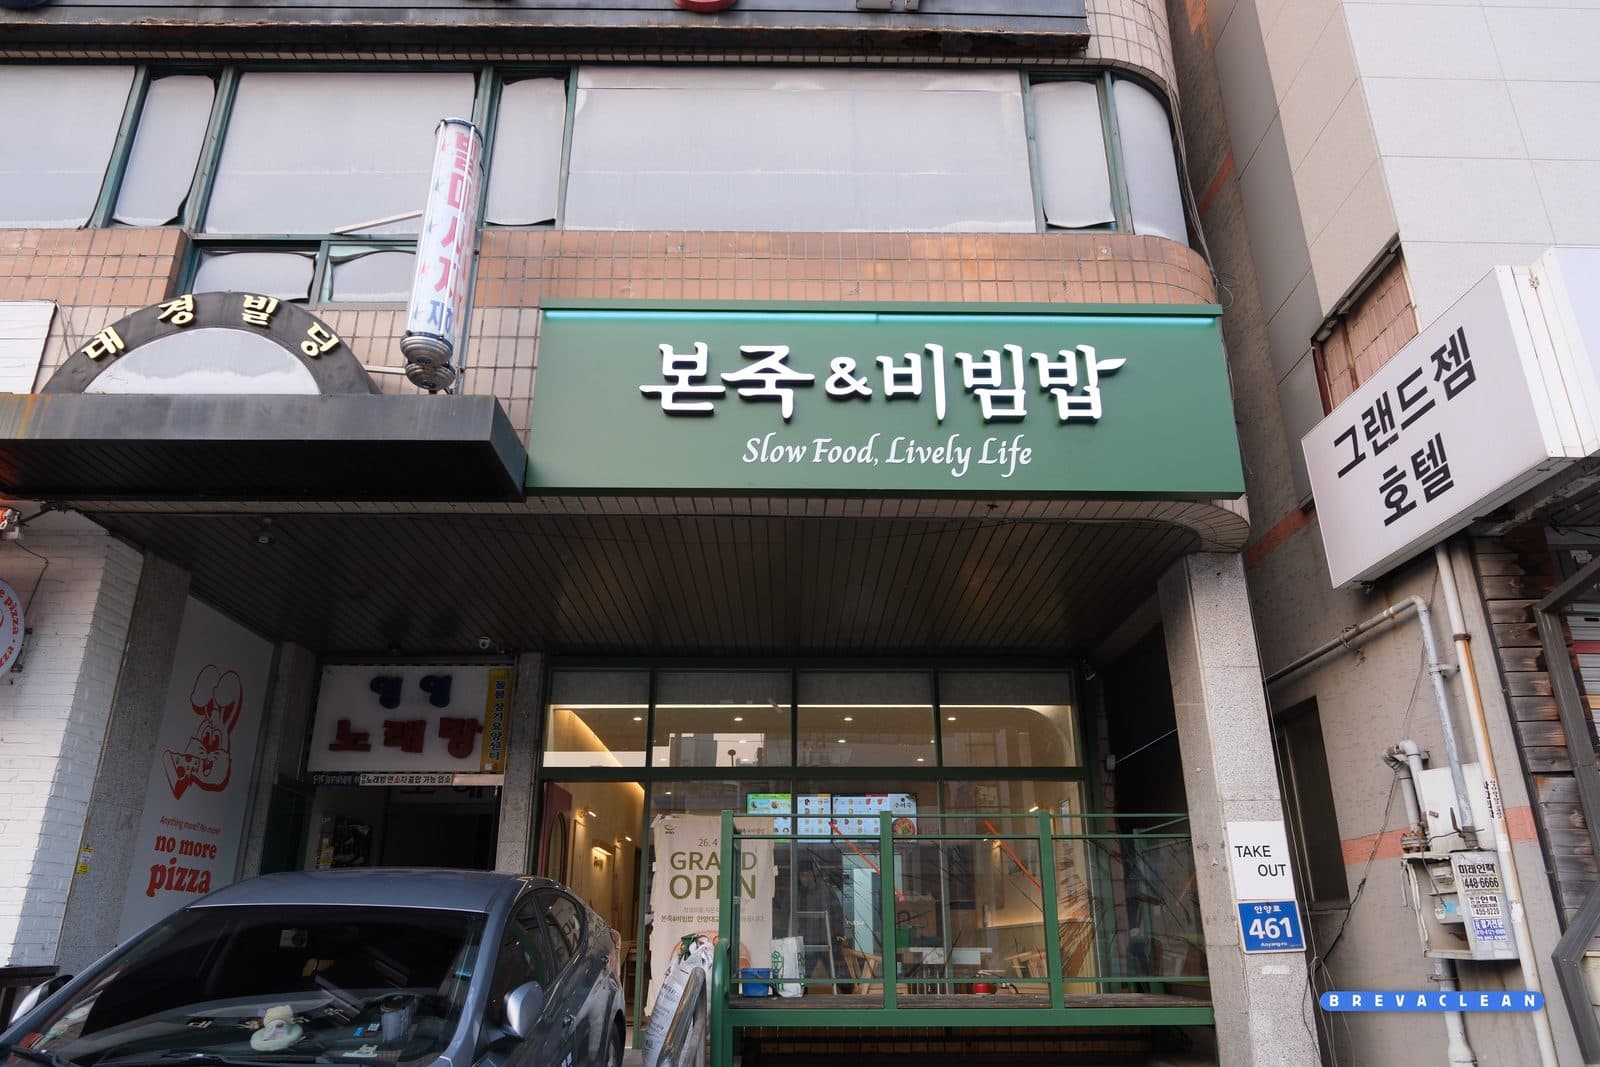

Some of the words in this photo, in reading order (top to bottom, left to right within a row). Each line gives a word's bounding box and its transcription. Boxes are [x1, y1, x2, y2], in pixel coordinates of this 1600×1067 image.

[639, 341, 1127, 423] 본죽&비빔밥
[1333, 326, 1477, 479] 그랜드젬
[742, 432, 807, 466] Slow
[812, 433, 879, 467] Food,
[884, 436, 972, 478] Lively
[978, 434, 1034, 478] Life
[1379, 432, 1455, 527] 호텔
[154, 834, 177, 853] no
[178, 839, 218, 860] more
[1234, 844, 1272, 859] TAKE
[670, 851, 758, 871] GRAD
[1257, 863, 1287, 878] OUT
[145, 857, 212, 898] pizza
[669, 874, 757, 900] OPN
[1254, 905, 1282, 914] 안양로
[1249, 916, 1293, 940] 461
